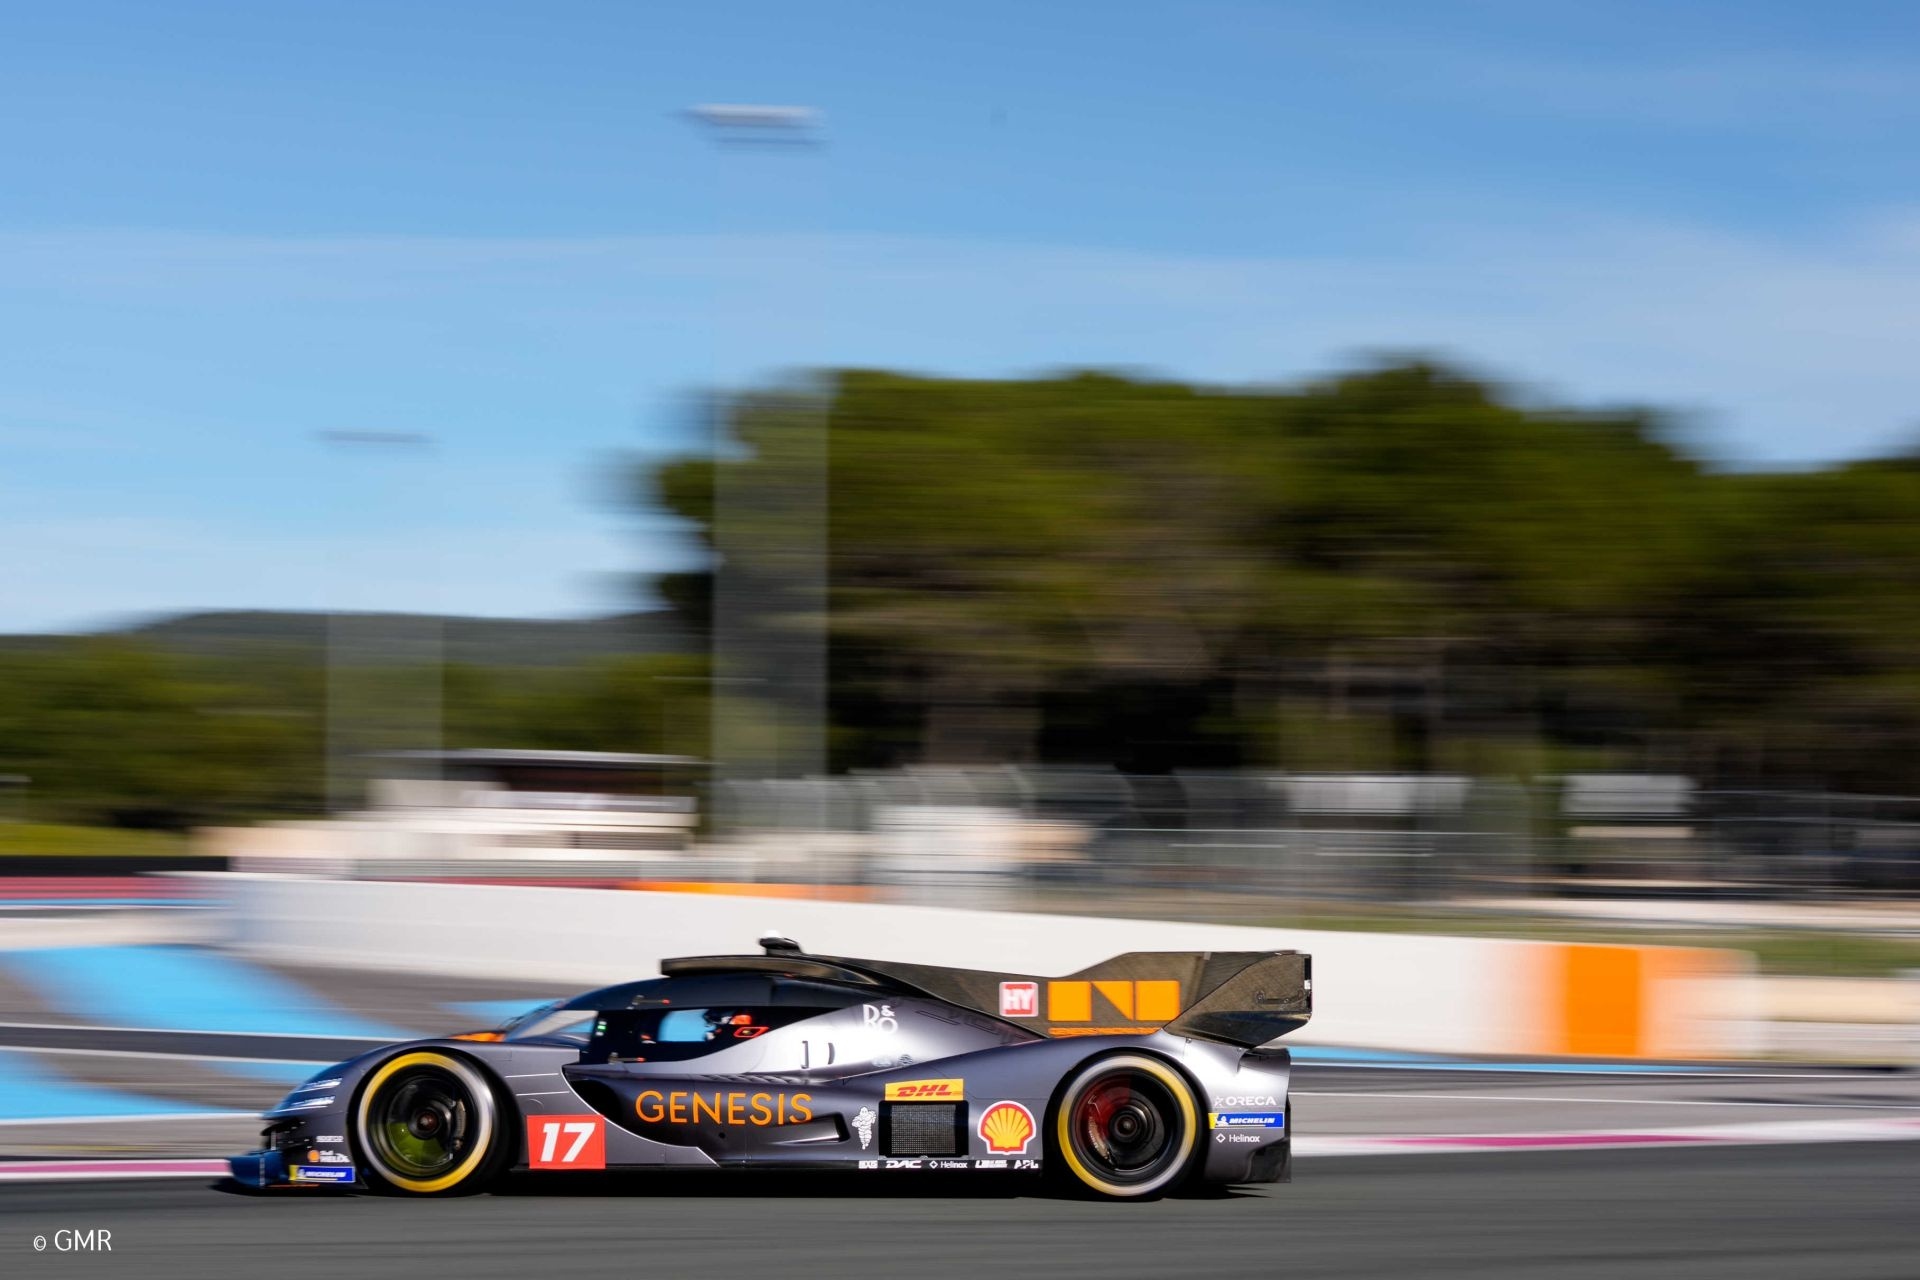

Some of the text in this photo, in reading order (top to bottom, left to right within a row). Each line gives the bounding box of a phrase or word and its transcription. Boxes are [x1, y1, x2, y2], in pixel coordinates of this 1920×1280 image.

[896, 1084, 953, 1097] DHL
[1225, 1096, 1277, 1106] ORECA
[635, 1090, 813, 1126] GENESIS
[540, 1122, 596, 1163] 17
[1228, 1133, 1261, 1143] Helinox
[885, 1160, 922, 1169] DAC
[940, 1160, 968, 1169] Helinox
